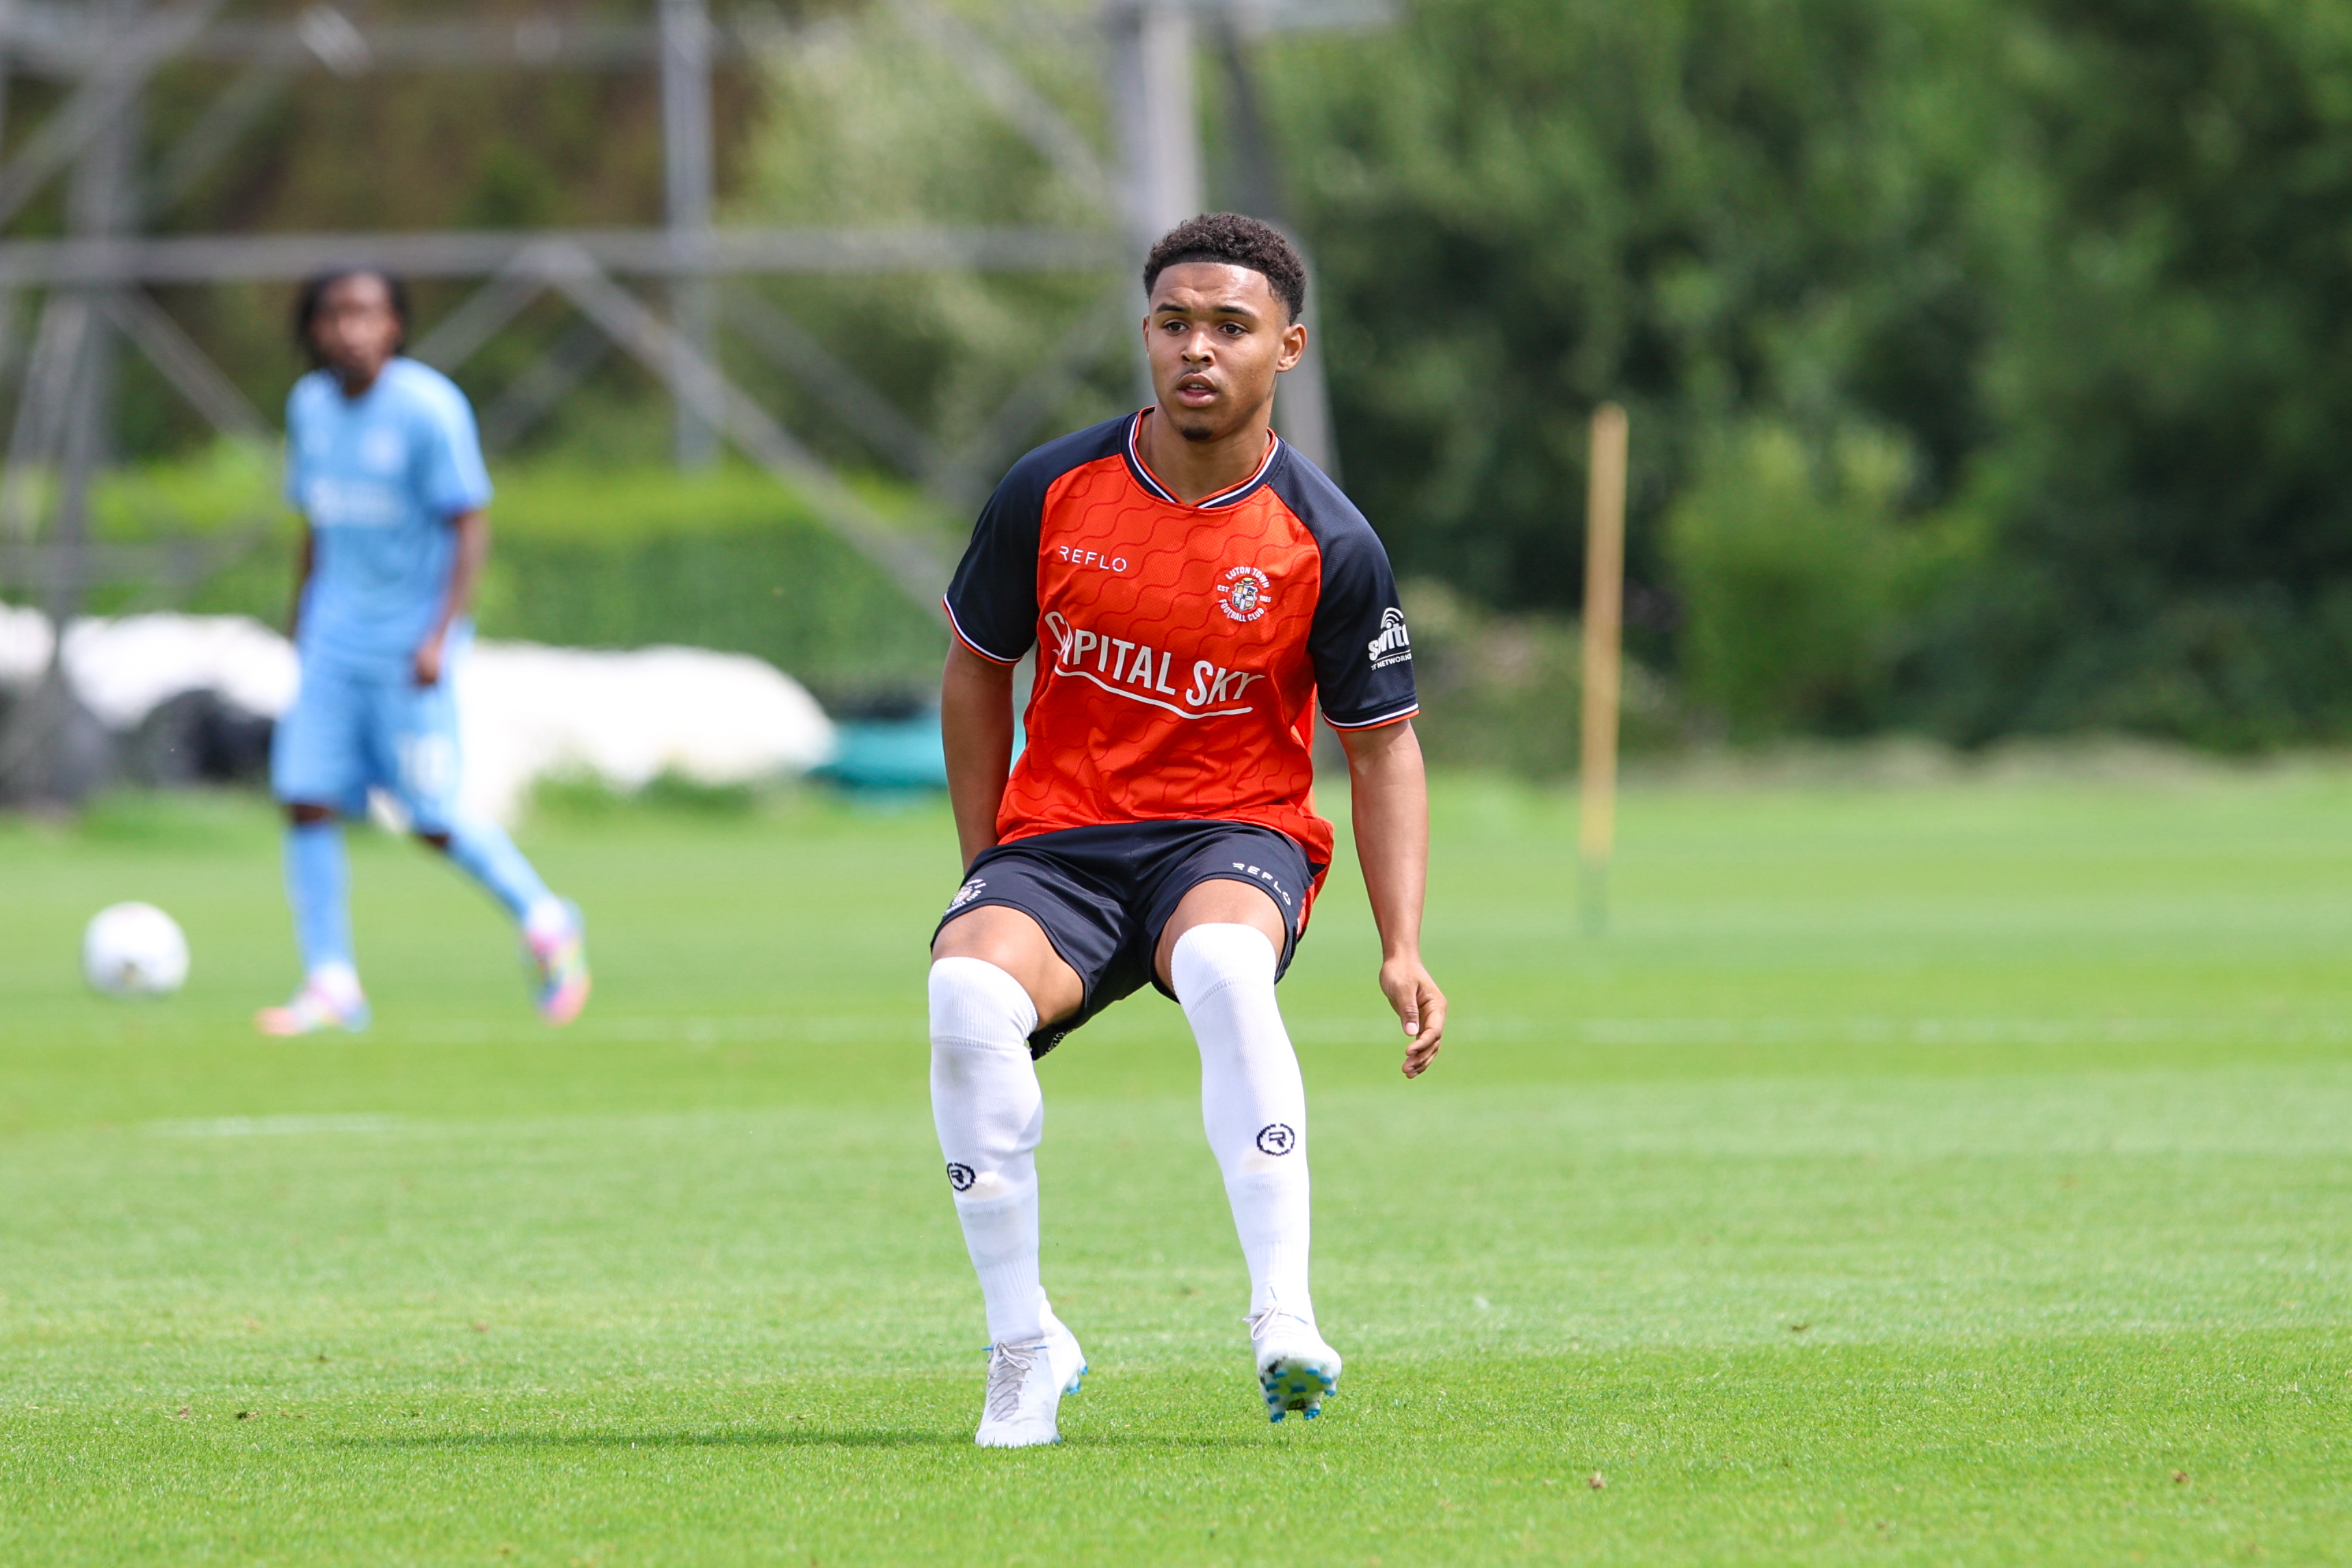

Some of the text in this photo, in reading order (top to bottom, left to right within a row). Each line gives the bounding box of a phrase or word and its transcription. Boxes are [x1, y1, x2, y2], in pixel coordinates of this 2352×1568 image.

[1059, 545, 1127, 572] REFLO
[1217, 585, 1230, 593] EST
[1225, 566, 1271, 589] LUTON TOWN
[1218, 598, 1265, 622] FOOTBALL CLUB
[1185, 660, 1266, 706] SKY
[1232, 862, 1291, 905] REFLO
